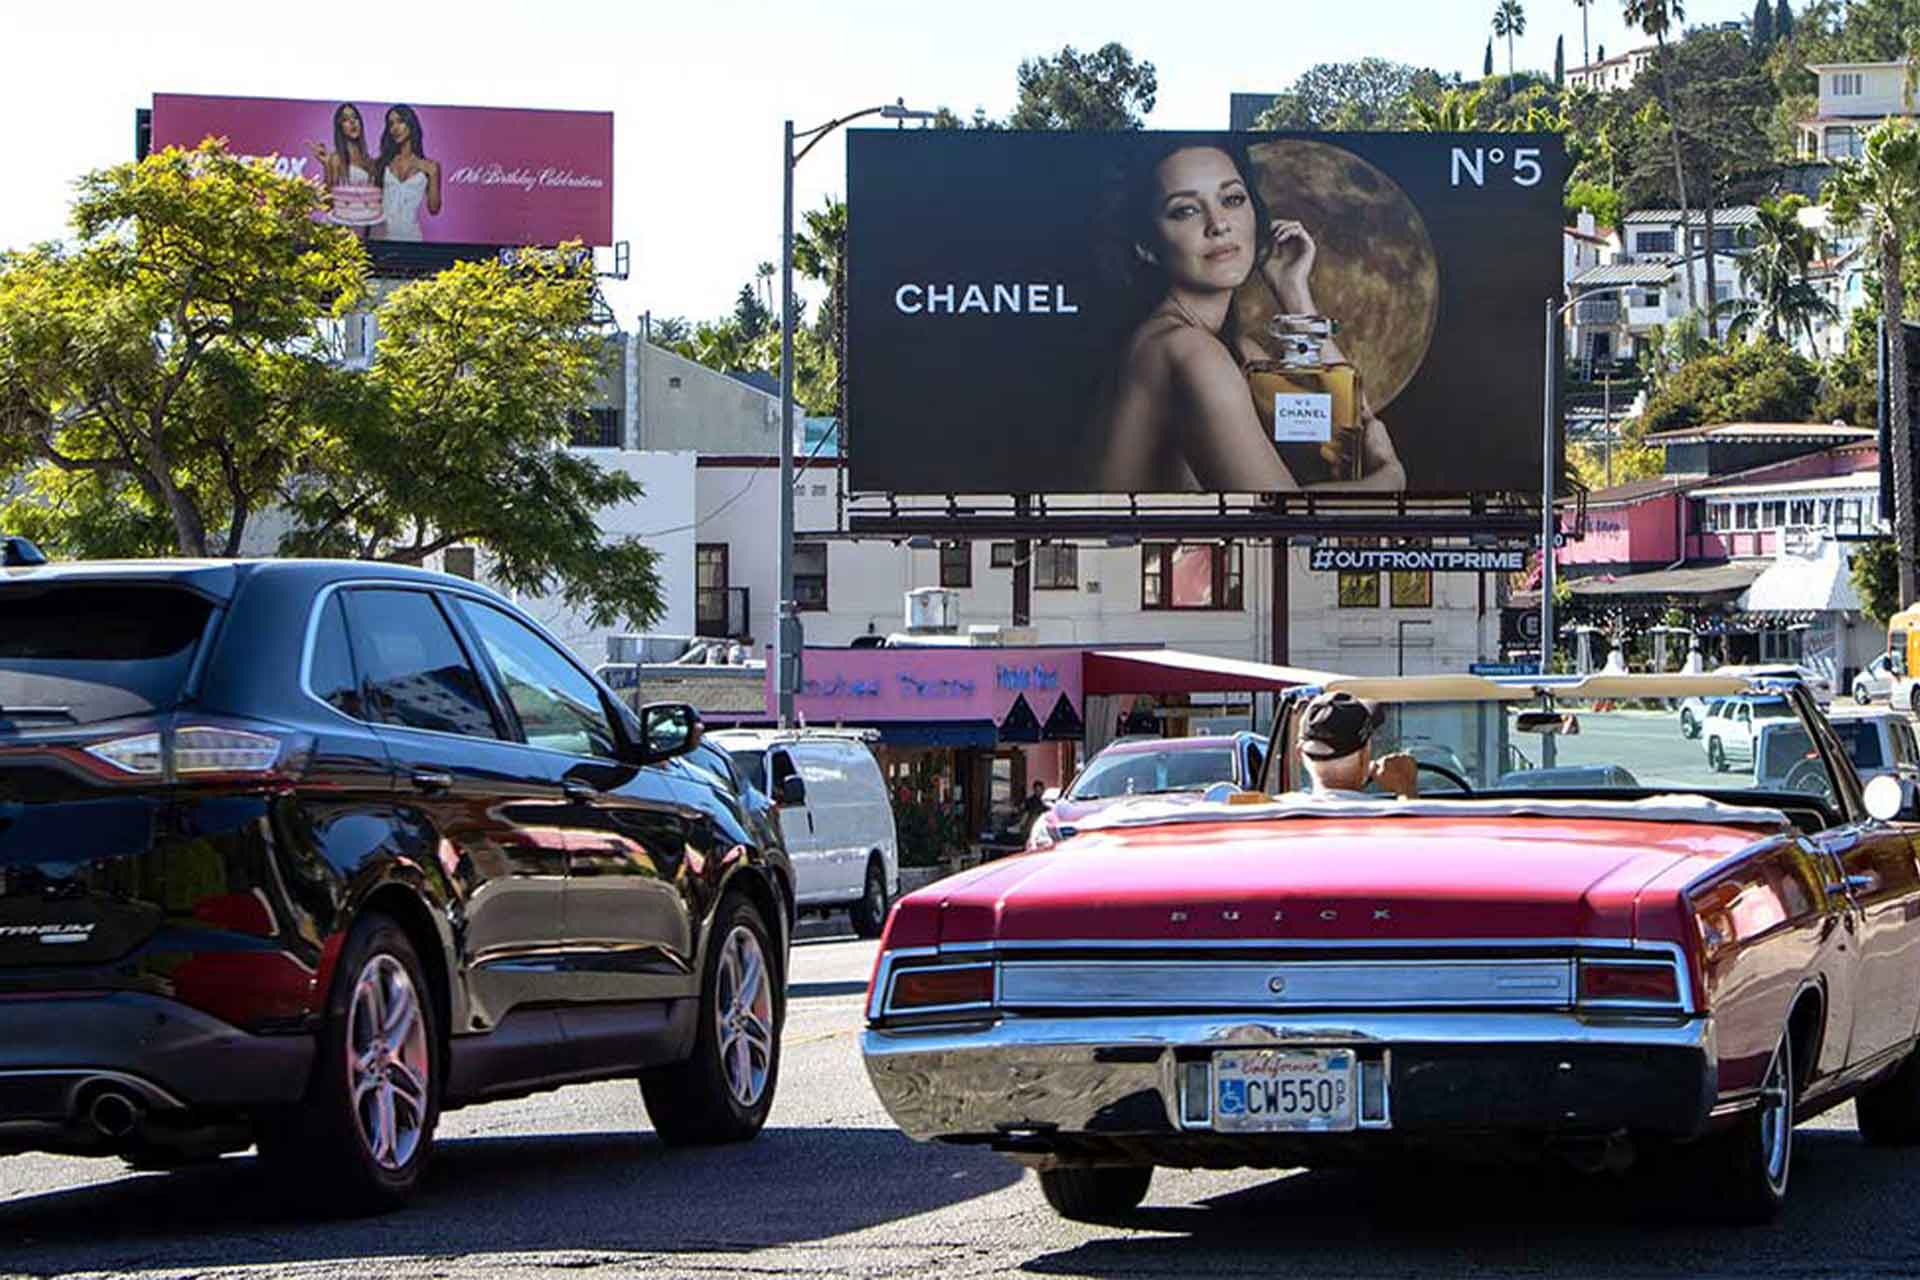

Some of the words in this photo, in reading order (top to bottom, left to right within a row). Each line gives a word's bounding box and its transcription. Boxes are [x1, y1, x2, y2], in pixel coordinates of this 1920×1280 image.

[481, 163, 537, 192] Birthday
[895, 284, 1078, 313] CHANEL
[1279, 408, 1328, 418] CHANEL
[1312, 551, 1524, 569] #OUTFRONTPRIME
[1247, 1079, 1334, 1114] CW550
